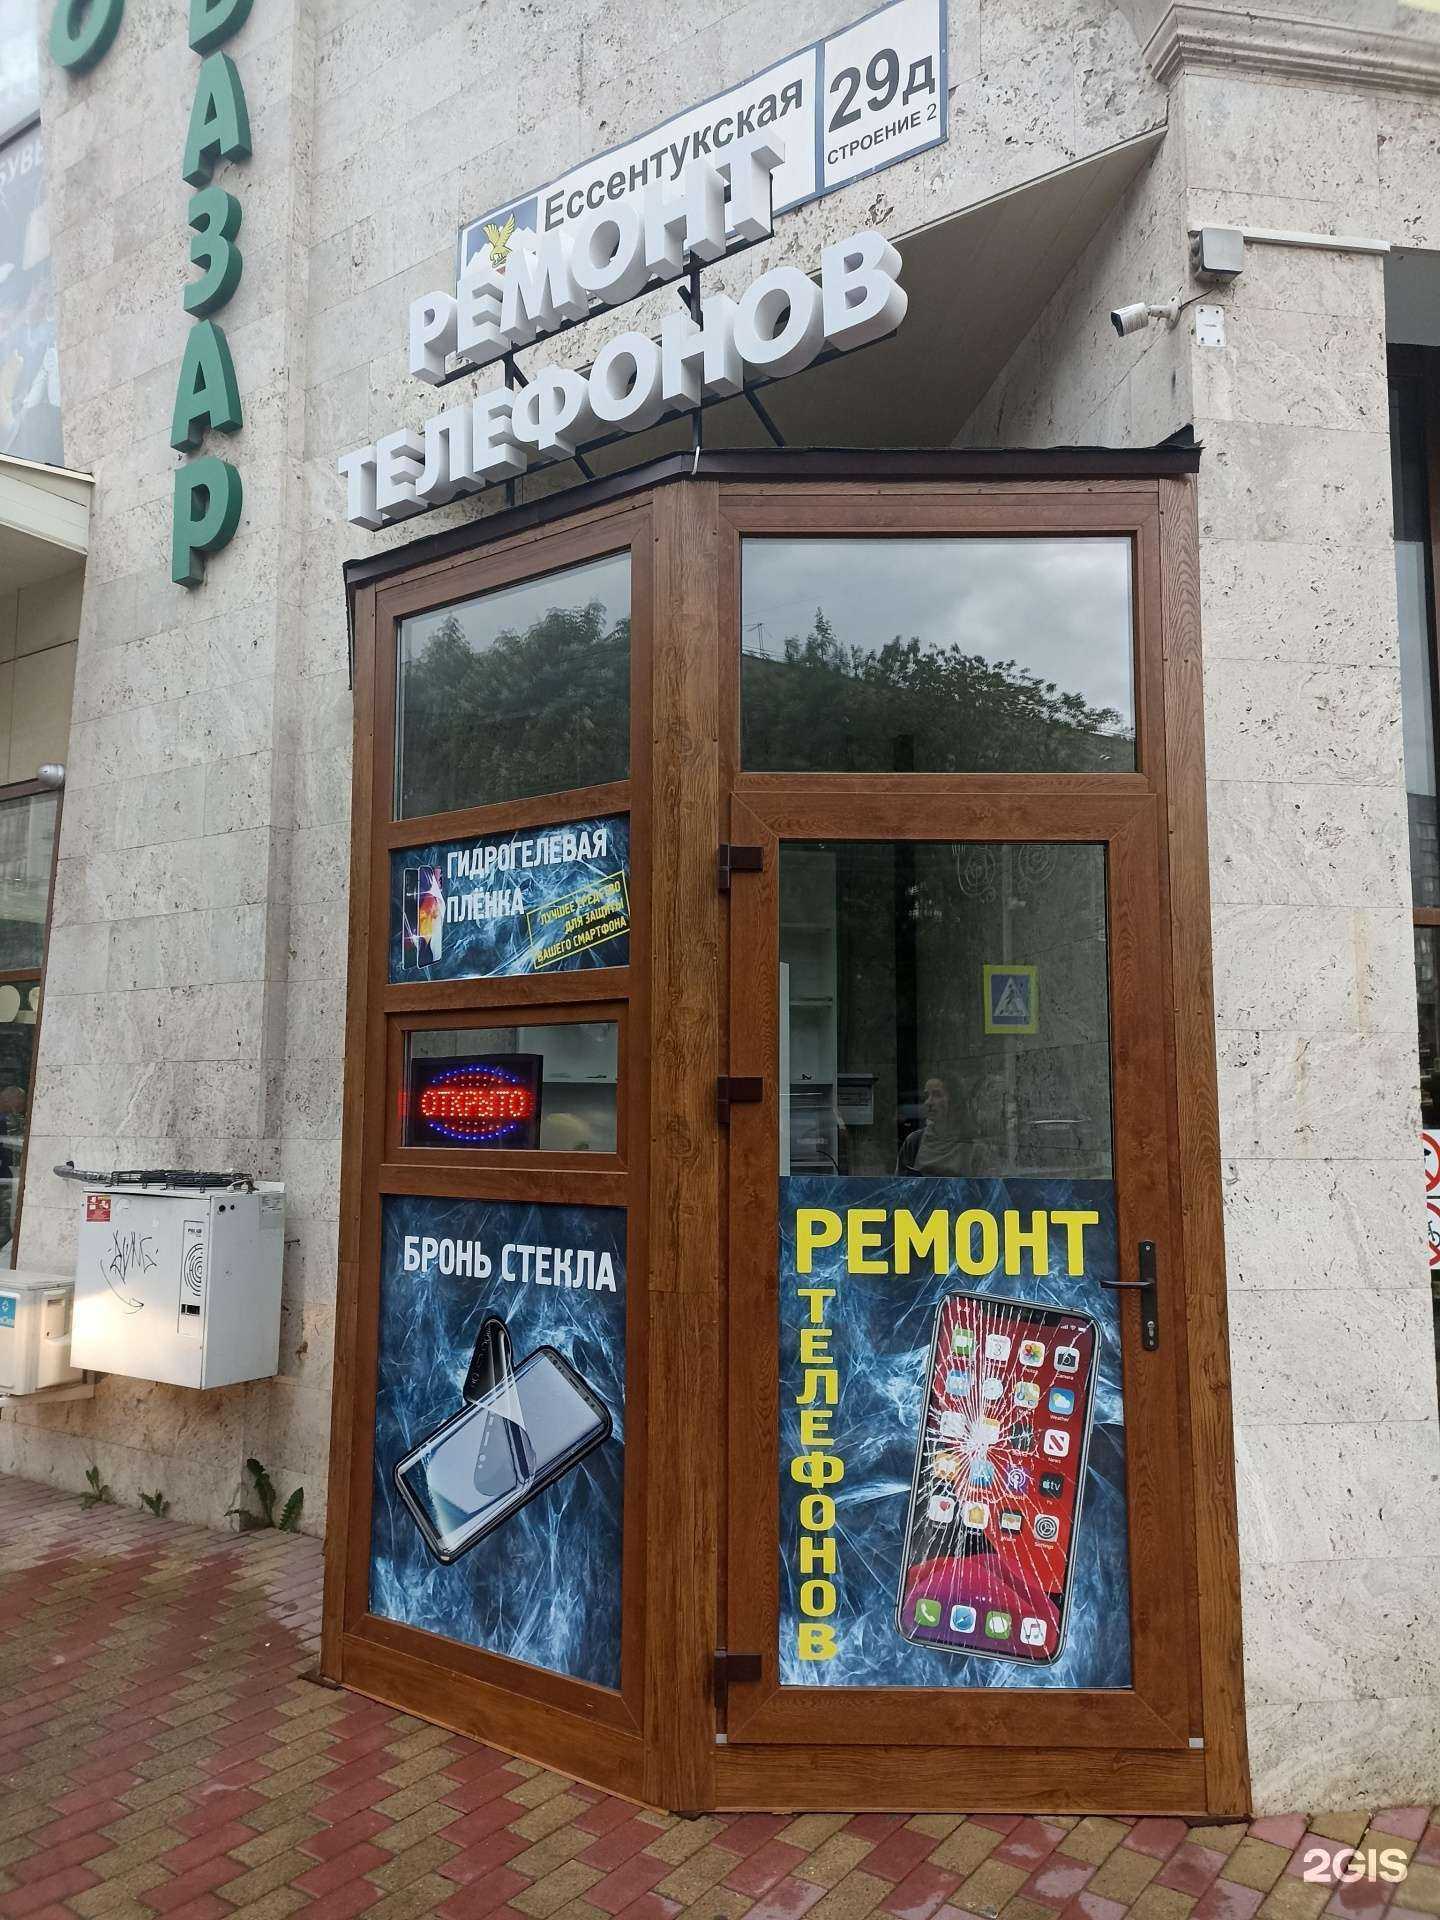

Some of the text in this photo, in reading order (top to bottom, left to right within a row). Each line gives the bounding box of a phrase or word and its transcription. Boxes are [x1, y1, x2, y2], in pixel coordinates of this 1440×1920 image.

[545, 79, 803, 232] Ессентукская
[827, 103, 937, 165] СТРОЕНИЕ 2
[409, 129, 785, 384] РЕМОНТ
[338, 231, 908, 530] ТЕЛЕФОНОВ
[447, 828, 607, 880] ГИДРОГЕЛЕВАЯ
[447, 886, 525, 923] ПЛЁНКА
[540, 901, 575, 925] ЛУЧШЕЕ
[565, 915, 583, 934] ДЛЯ
[537, 916, 627, 962] ВАШЕГО СМАРТФОНА
[421, 1090, 525, 1117] ОТКРЫТО
[404, 1235, 617, 1293] БРОНЬ СТЕКЛА
[796, 1208, 1099, 1277] РЕМОНТ
[790, 1288, 844, 1661] ТЕЛЕФОНОВ
